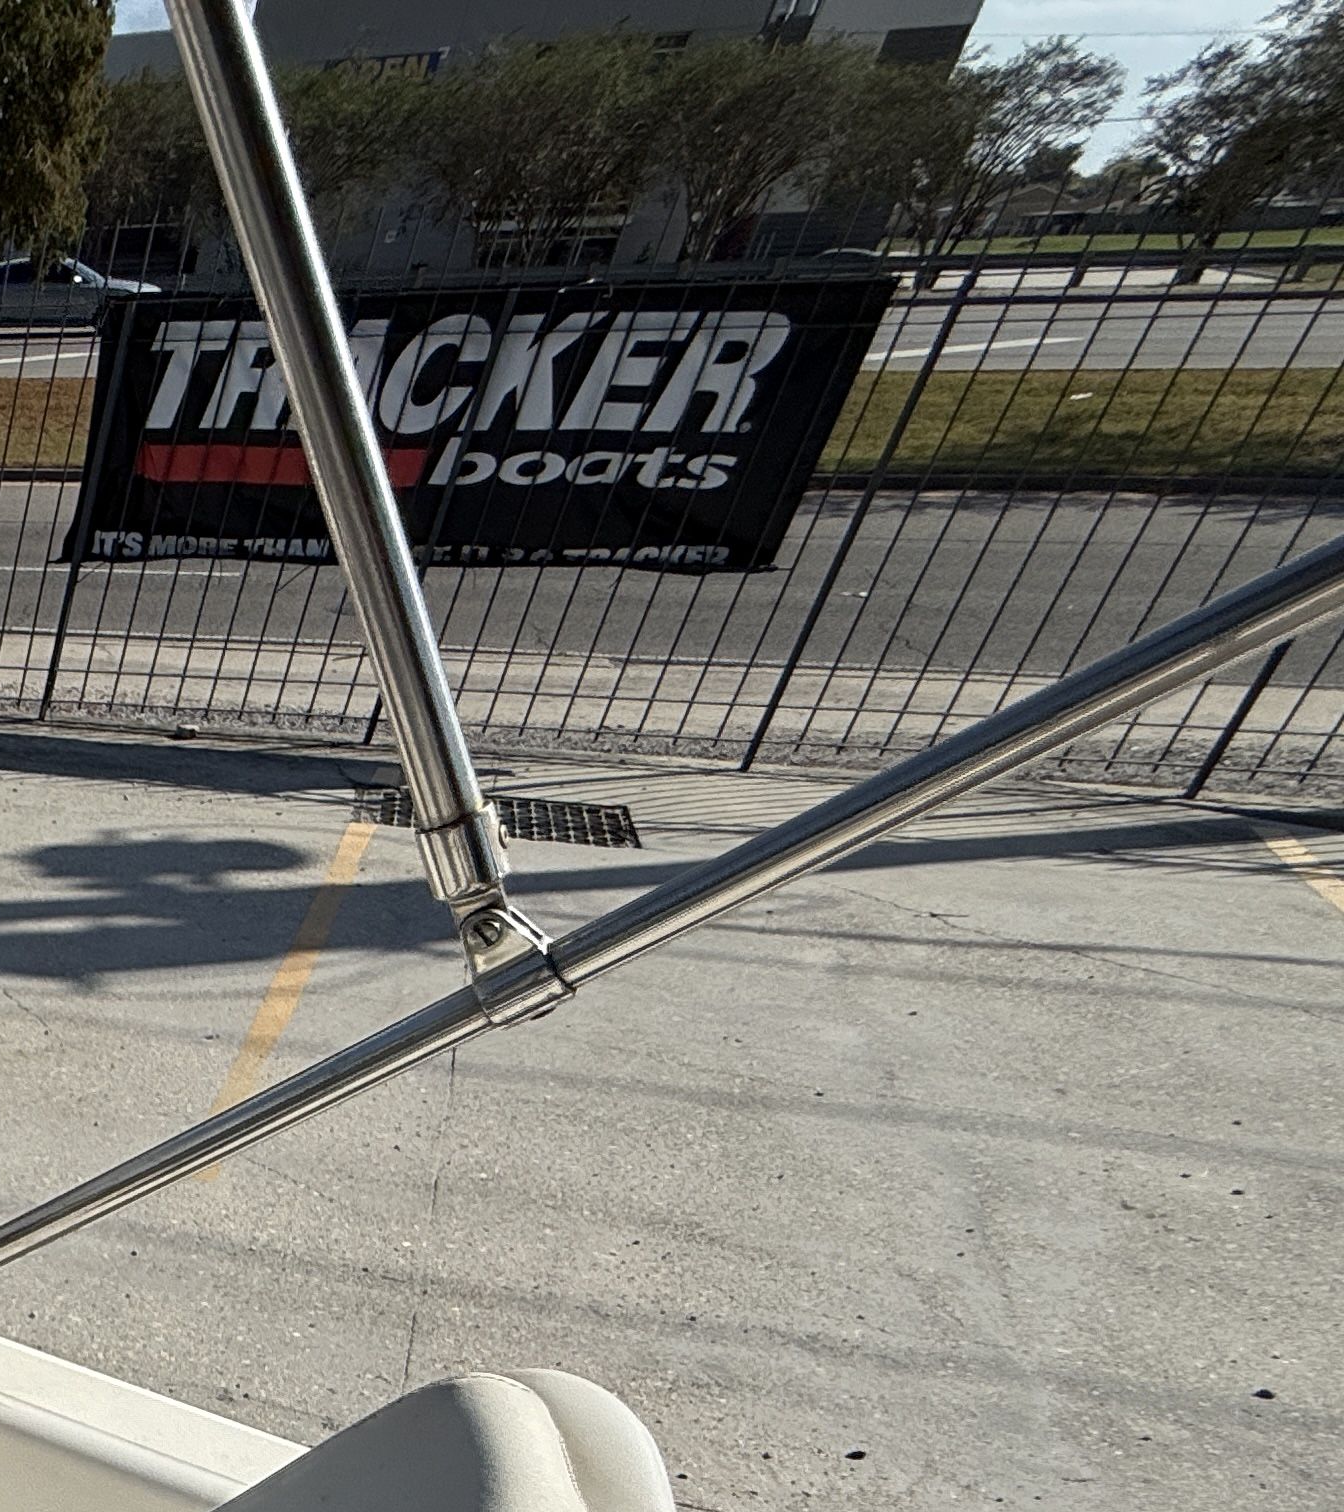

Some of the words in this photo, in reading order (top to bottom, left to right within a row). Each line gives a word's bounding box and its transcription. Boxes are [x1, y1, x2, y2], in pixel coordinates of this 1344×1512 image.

[427, 437, 738, 490] boats
[92, 530, 144, 557] IT'S
[148, 535, 238, 556] MORE
[244, 538, 329, 558] THAN
